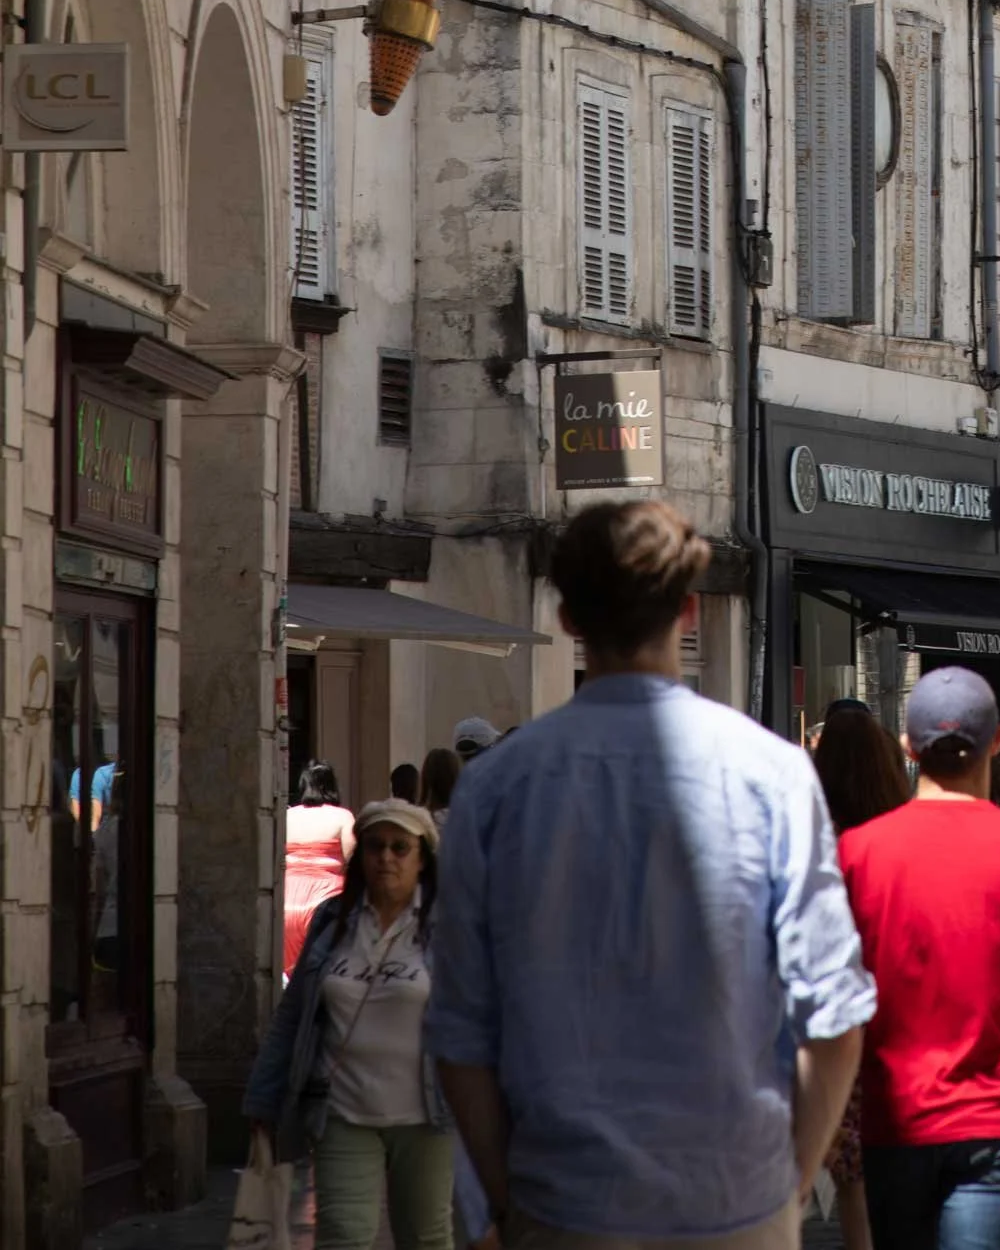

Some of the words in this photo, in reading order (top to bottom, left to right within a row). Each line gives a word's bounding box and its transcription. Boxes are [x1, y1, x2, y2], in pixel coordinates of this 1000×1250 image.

[26, 73, 110, 100] LCL
[564, 392, 592, 421] la
[597, 391, 654, 419] mie
[562, 425, 653, 453] CALINE
[819, 463, 885, 508] VISION
[886, 473, 992, 521] ROCHELAISE
[956, 631, 986, 653] VISION
